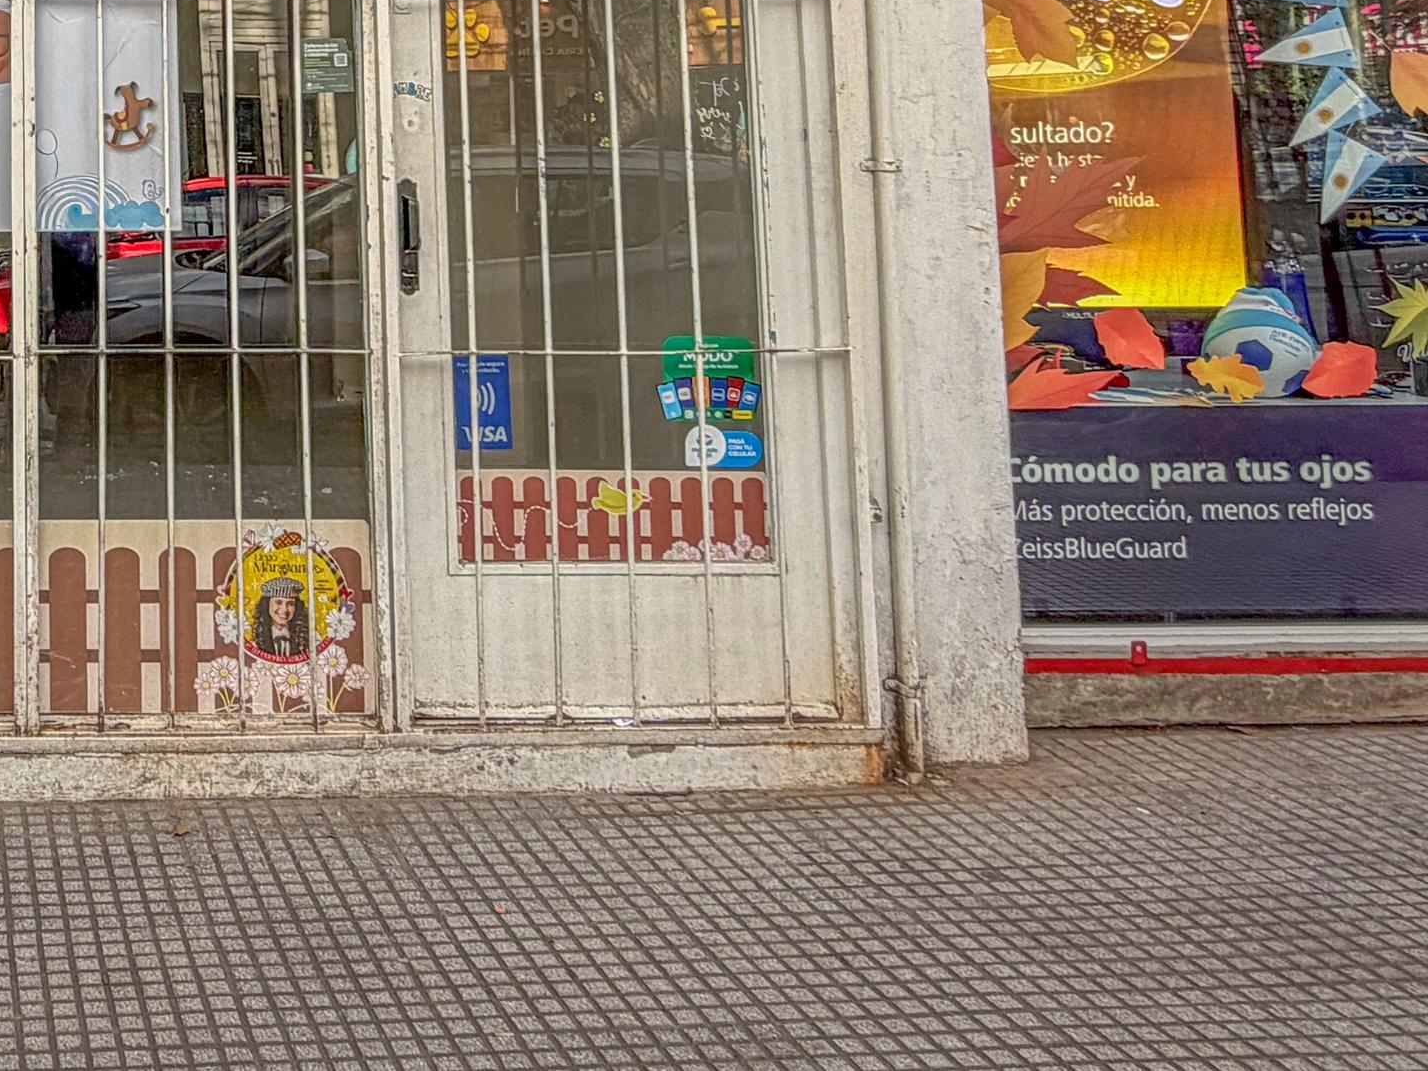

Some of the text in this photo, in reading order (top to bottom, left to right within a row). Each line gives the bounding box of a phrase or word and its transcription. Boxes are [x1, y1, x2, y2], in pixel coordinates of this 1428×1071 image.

[1150, 460, 1228, 490] para
[1236, 456, 1290, 482] tus
[1299, 453, 1372, 489] ojos
[1061, 498, 1193, 527] protección,
[1201, 501, 1280, 522] menos
[1287, 496, 1374, 526] reflejos
